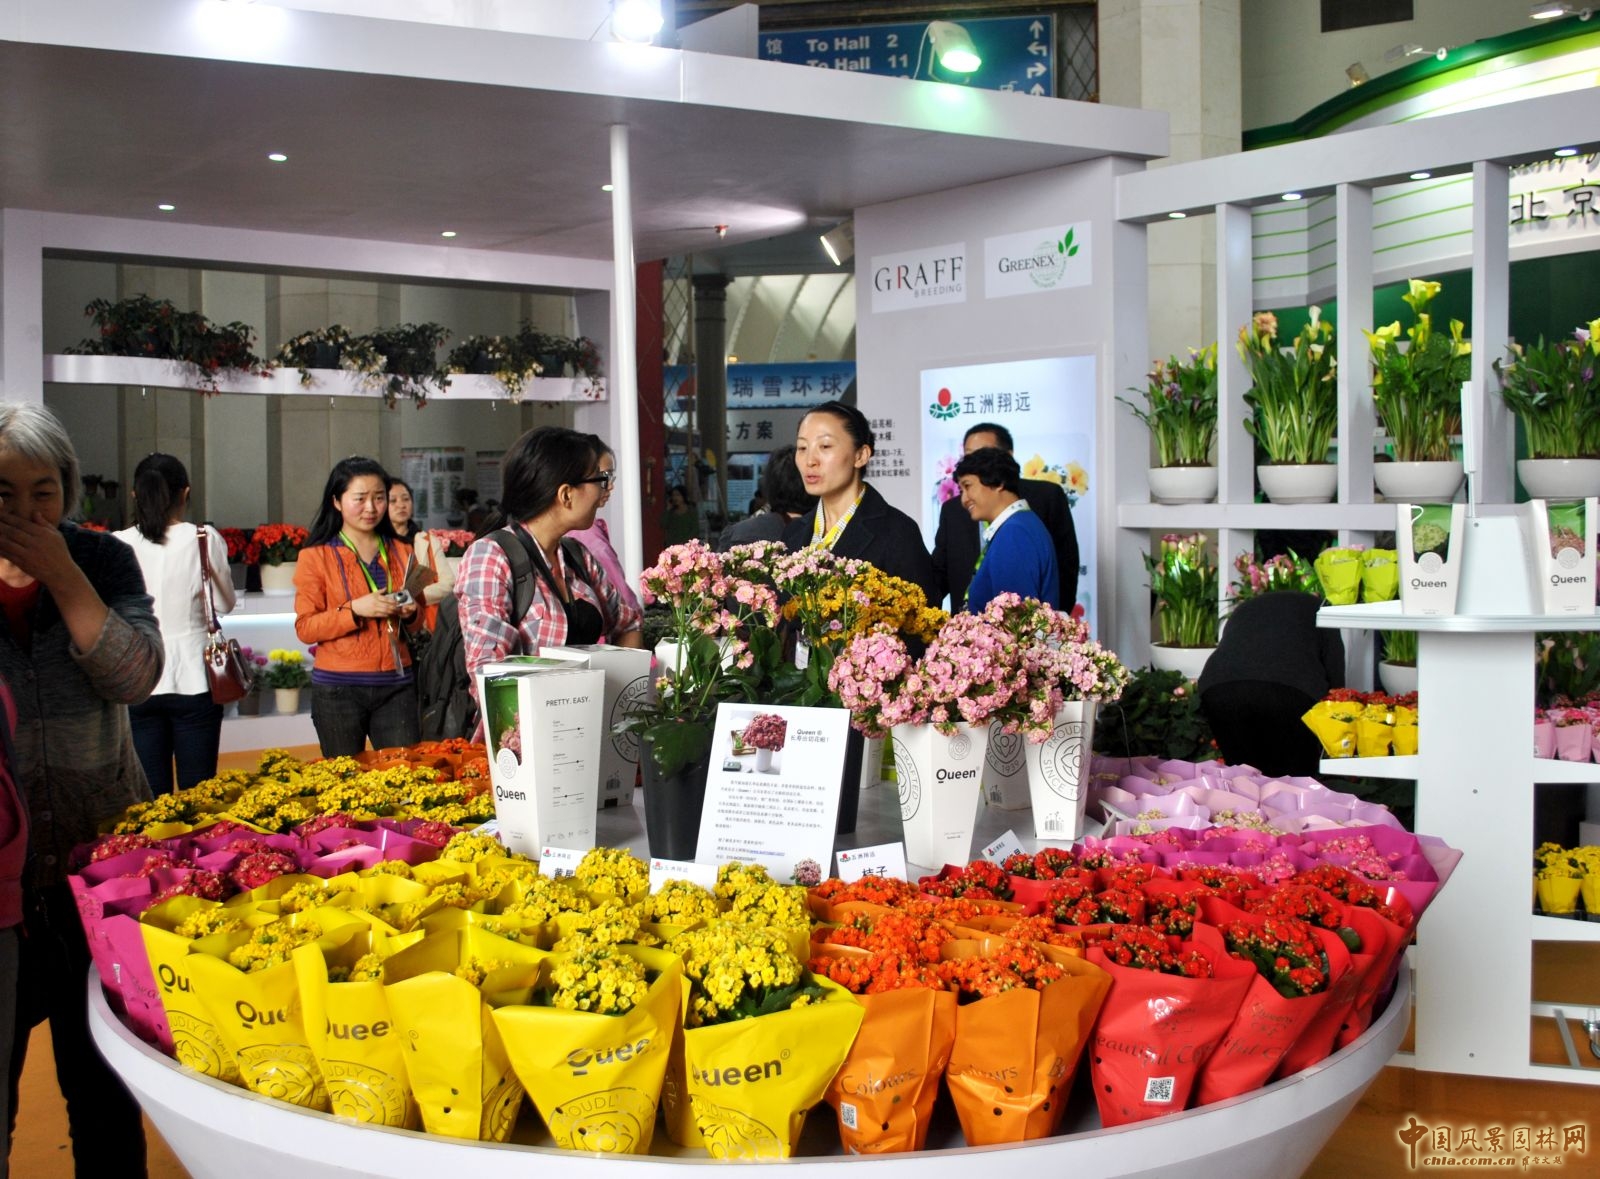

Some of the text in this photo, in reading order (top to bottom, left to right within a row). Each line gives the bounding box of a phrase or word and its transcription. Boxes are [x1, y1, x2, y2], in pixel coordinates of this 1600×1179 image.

[766, 34, 898, 55] 馆 To Hall 2
[835, 57, 871, 71] Hall
[888, 54, 909, 69] 11
[1510, 178, 1600, 225] 北京
[874, 256, 964, 292] GRAFF
[914, 283, 963, 298] BREEDING
[732, 373, 843, 398] 瑞雪环球
[962, 391, 1031, 414] 五洲翔远
[1411, 578, 1447, 590] Queen
[1551, 575, 1587, 587] Queen
[546, 696, 591, 707] PRETTY. EASY.
[900, 749, 919, 801] CRAFTED
[936, 768, 976, 784] Queen
[1001, 760, 1019, 774] 1939
[1043, 759, 1066, 793] SINCE
[496, 785, 526, 801] Queen
[158, 963, 196, 993] Qu
[326, 1017, 394, 1041] uee
